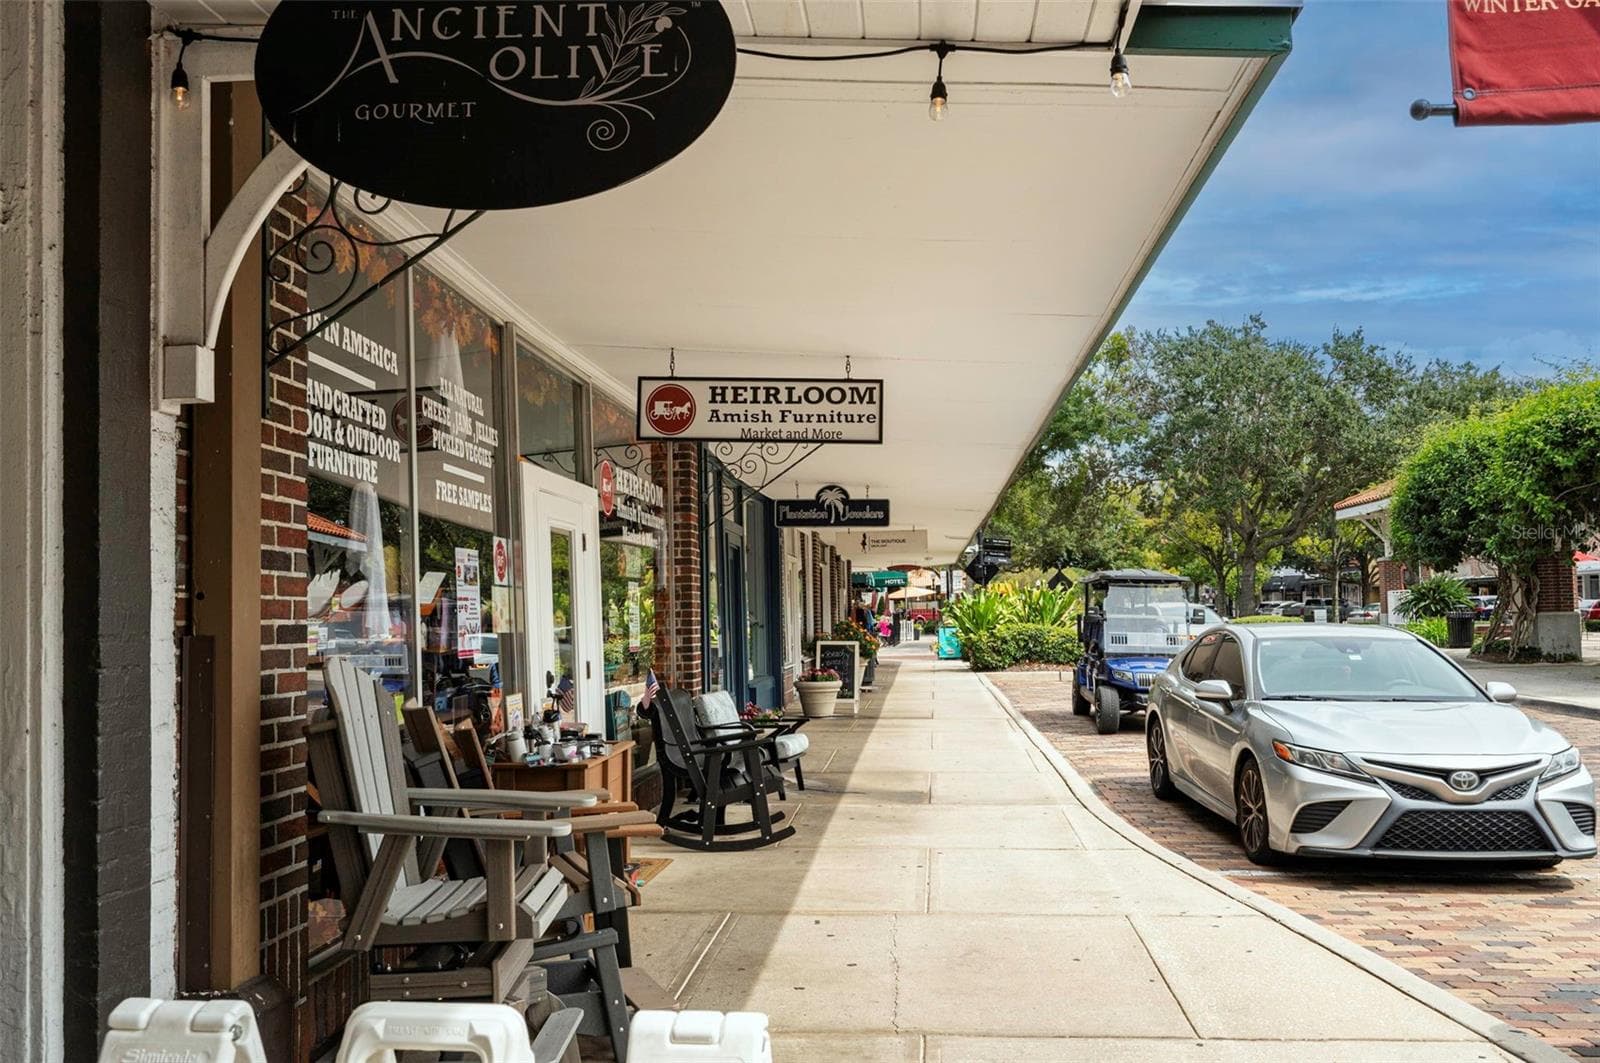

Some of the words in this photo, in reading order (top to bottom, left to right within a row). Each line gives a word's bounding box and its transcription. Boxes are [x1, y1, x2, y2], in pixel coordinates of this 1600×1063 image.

[331, 9, 358, 20] THE
[1464, 0, 1559, 13] WINTER
[318, 3, 607, 86] ANCIENT
[488, 44, 669, 80] OLIVE
[355, 102, 477, 125] GOURMET
[342, 325, 398, 376] AMERICA
[306, 377, 387, 431] ANDCRAFTED
[440, 376, 454, 402] ALL
[454, 384, 484, 417] NATURAL
[707, 385, 877, 405] HEIRLOOM
[707, 409, 773, 424] Amish
[779, 410, 877, 425] Furniture
[740, 427, 782, 441] Market
[786, 427, 807, 441] and
[811, 428, 843, 441] More
[334, 419, 345, 446] &
[346, 423, 401, 463] OUTDOOR
[432, 427, 464, 459] PICKLED
[464, 441, 494, 469] VEGGIES
[307, 440, 379, 485] FURNITURE
[435, 479, 459, 505] FREE
[458, 486, 493, 513] SAMPLES
[615, 465, 664, 509] HEIRLOOM
[884, 578, 906, 586] HOTEL
